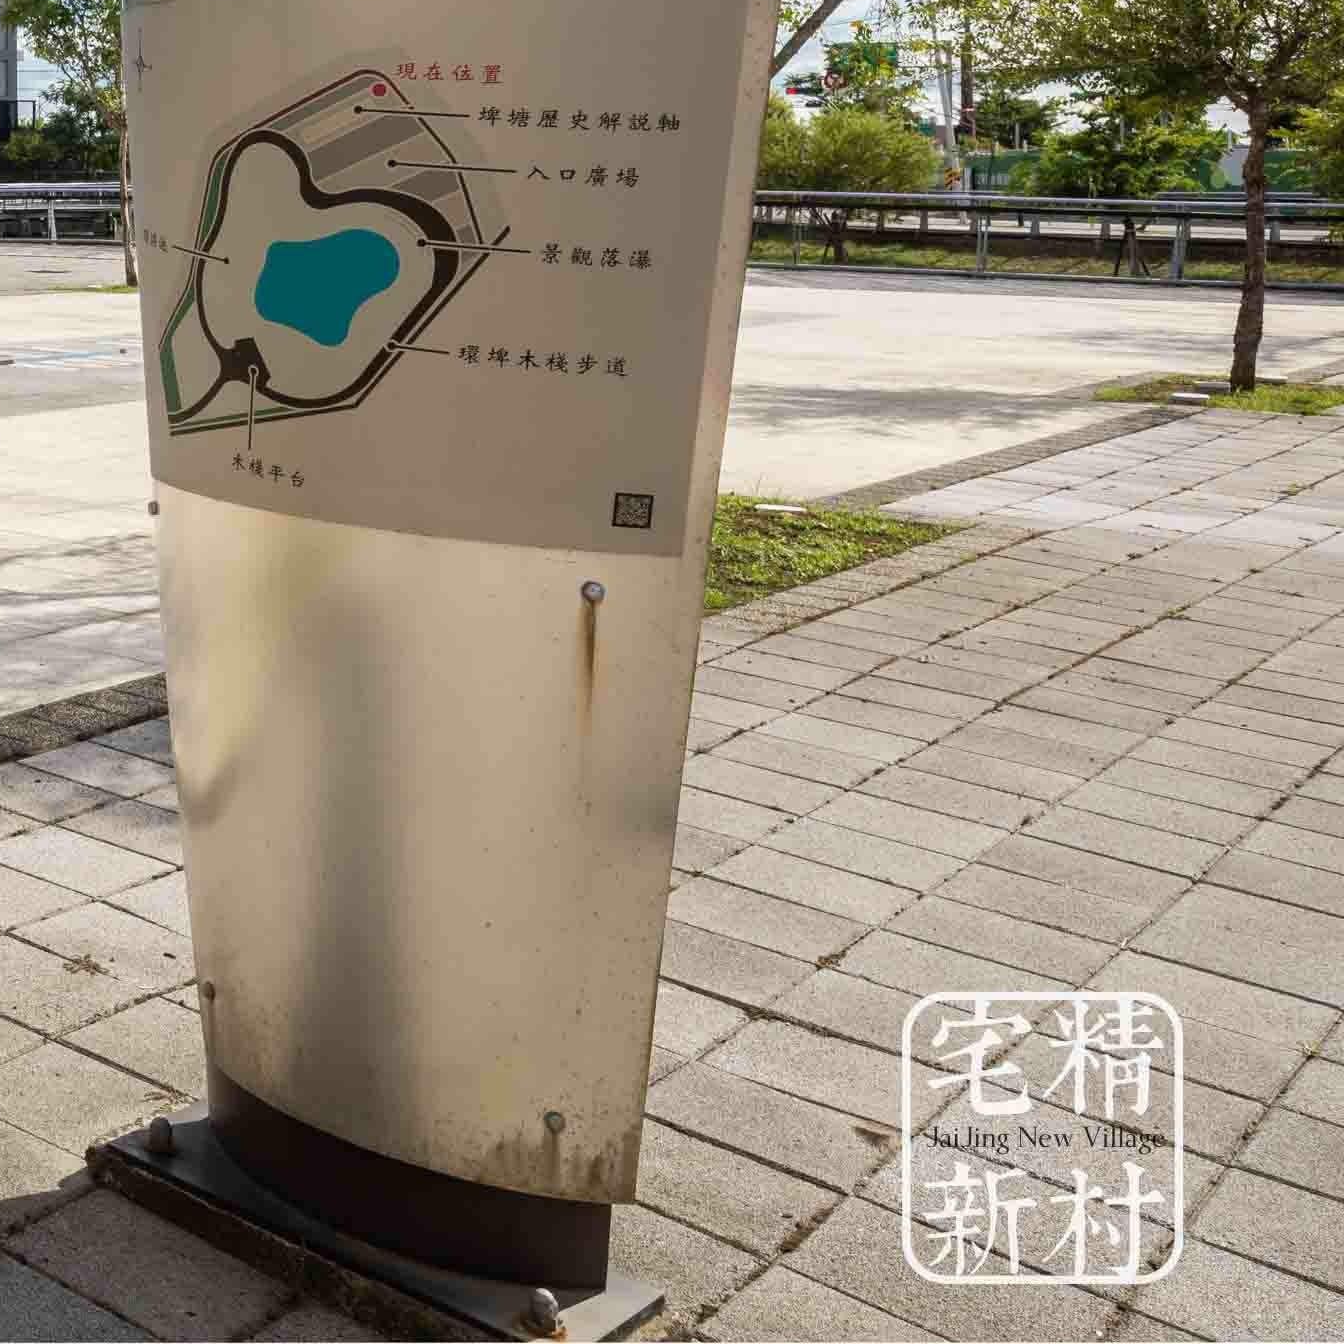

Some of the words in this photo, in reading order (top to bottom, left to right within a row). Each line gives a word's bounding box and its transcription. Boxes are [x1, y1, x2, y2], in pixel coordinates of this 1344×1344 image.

[397, 62, 504, 84] 現在位置
[527, 164, 640, 188] 入口廣場
